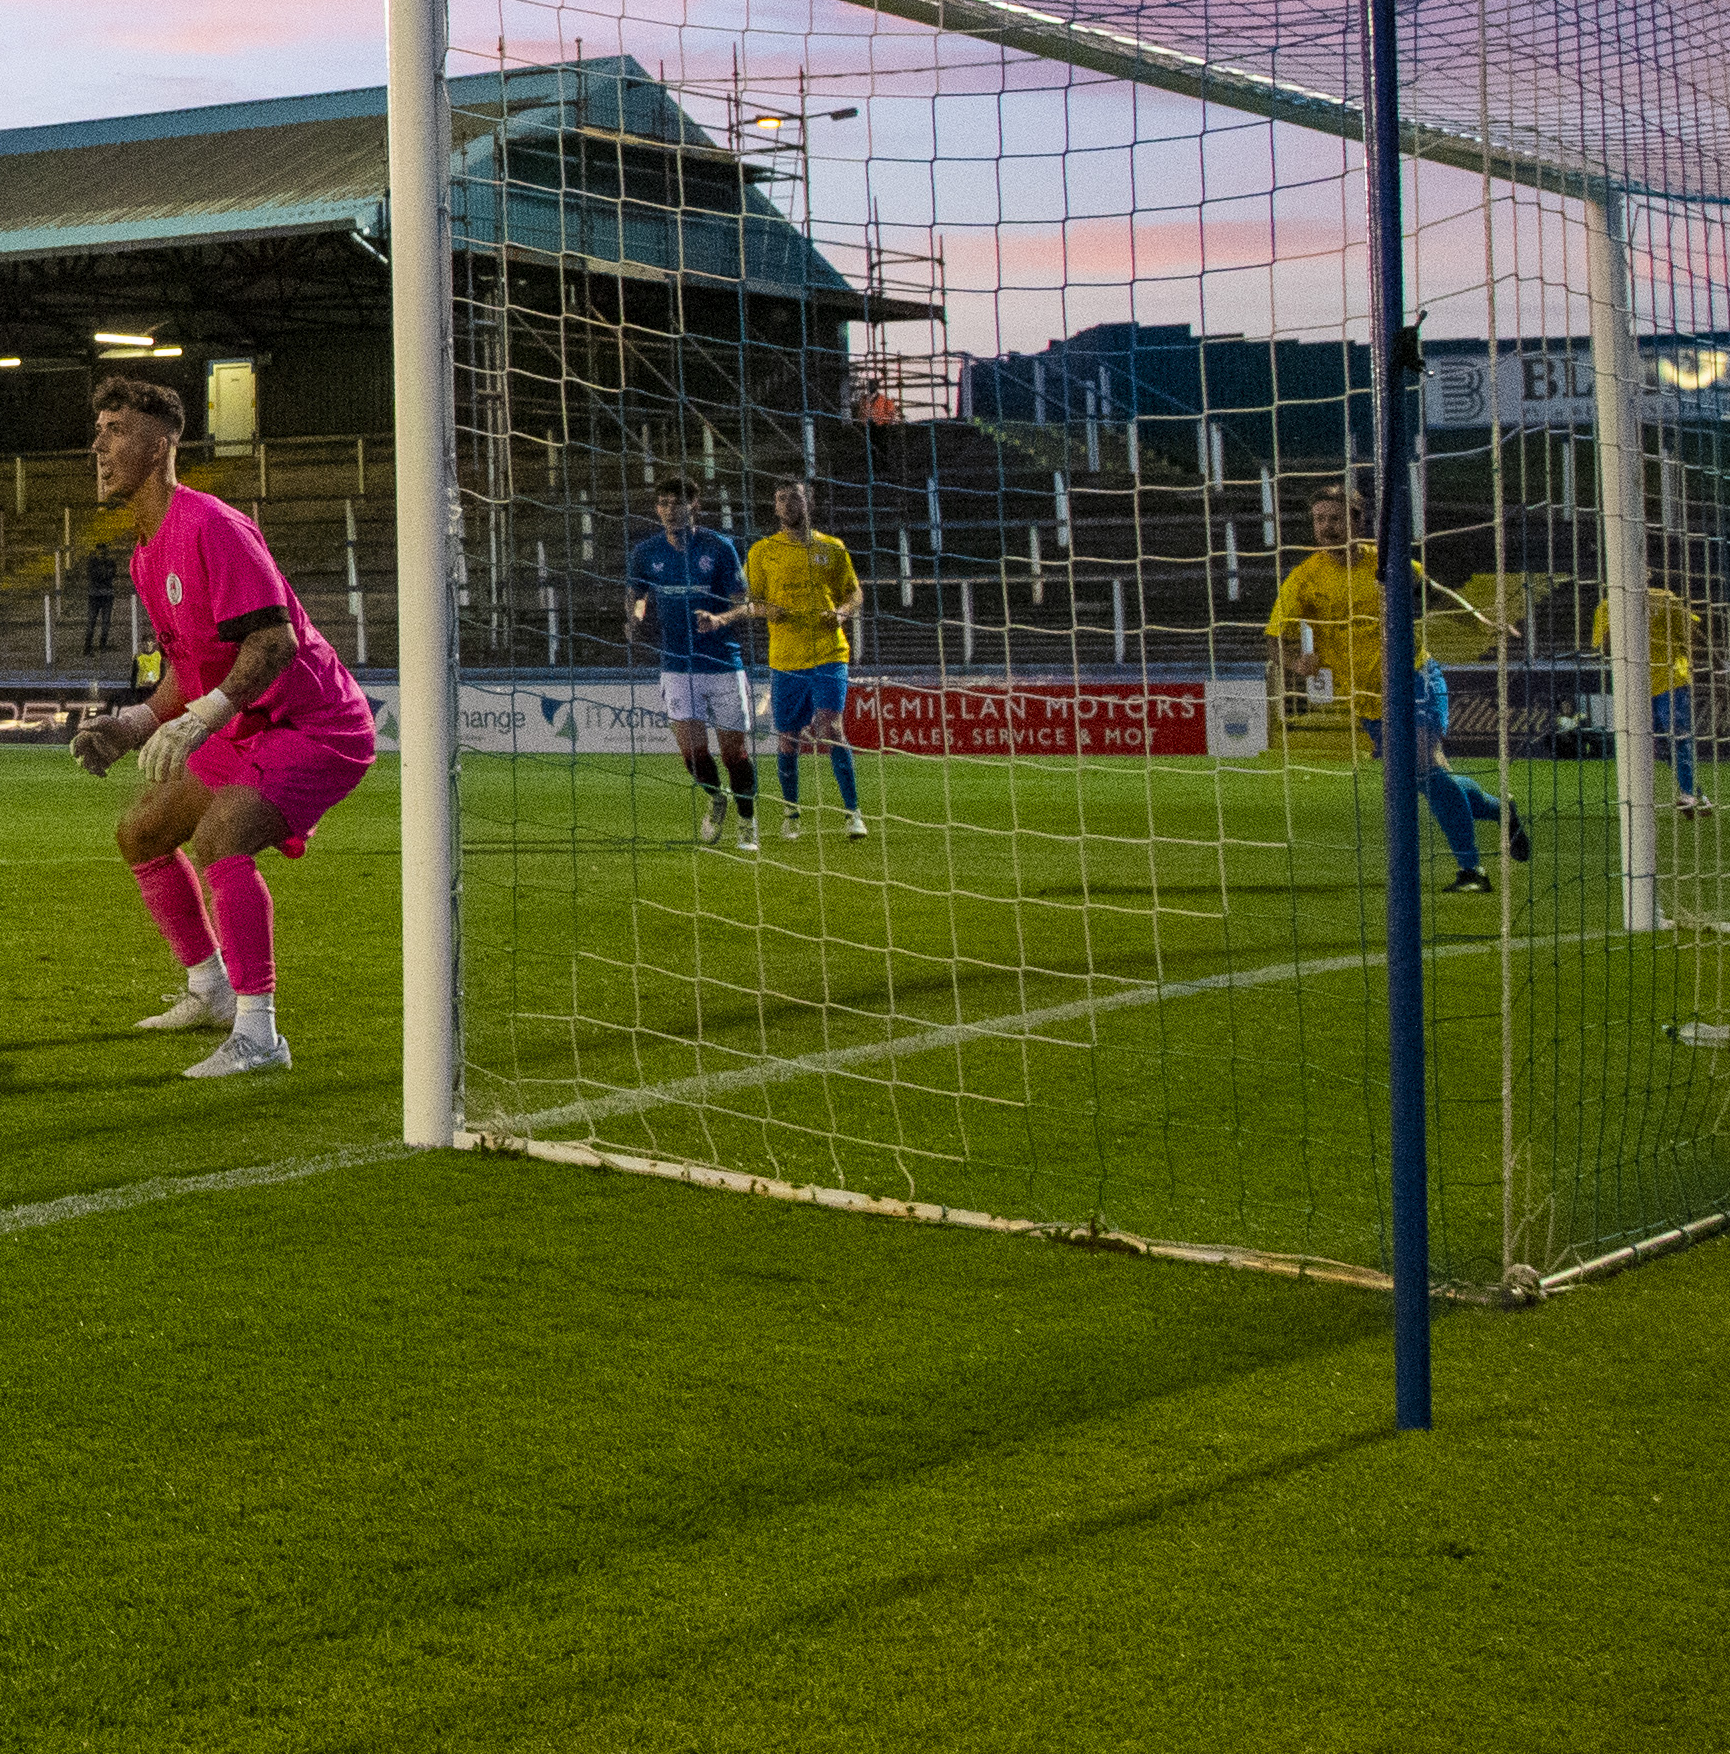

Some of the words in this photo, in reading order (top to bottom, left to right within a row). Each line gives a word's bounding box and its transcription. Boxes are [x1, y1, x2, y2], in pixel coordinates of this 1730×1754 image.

[610, 706, 668, 729] Xcha
[855, 696, 1027, 720] McMILLAN
[1046, 694, 1195, 719] MOTORS
[889, 728, 963, 748] SALES,
[971, 728, 1066, 746] SERVICE
[1079, 728, 1092, 746] &
[1104, 728, 1157, 746] MOT
